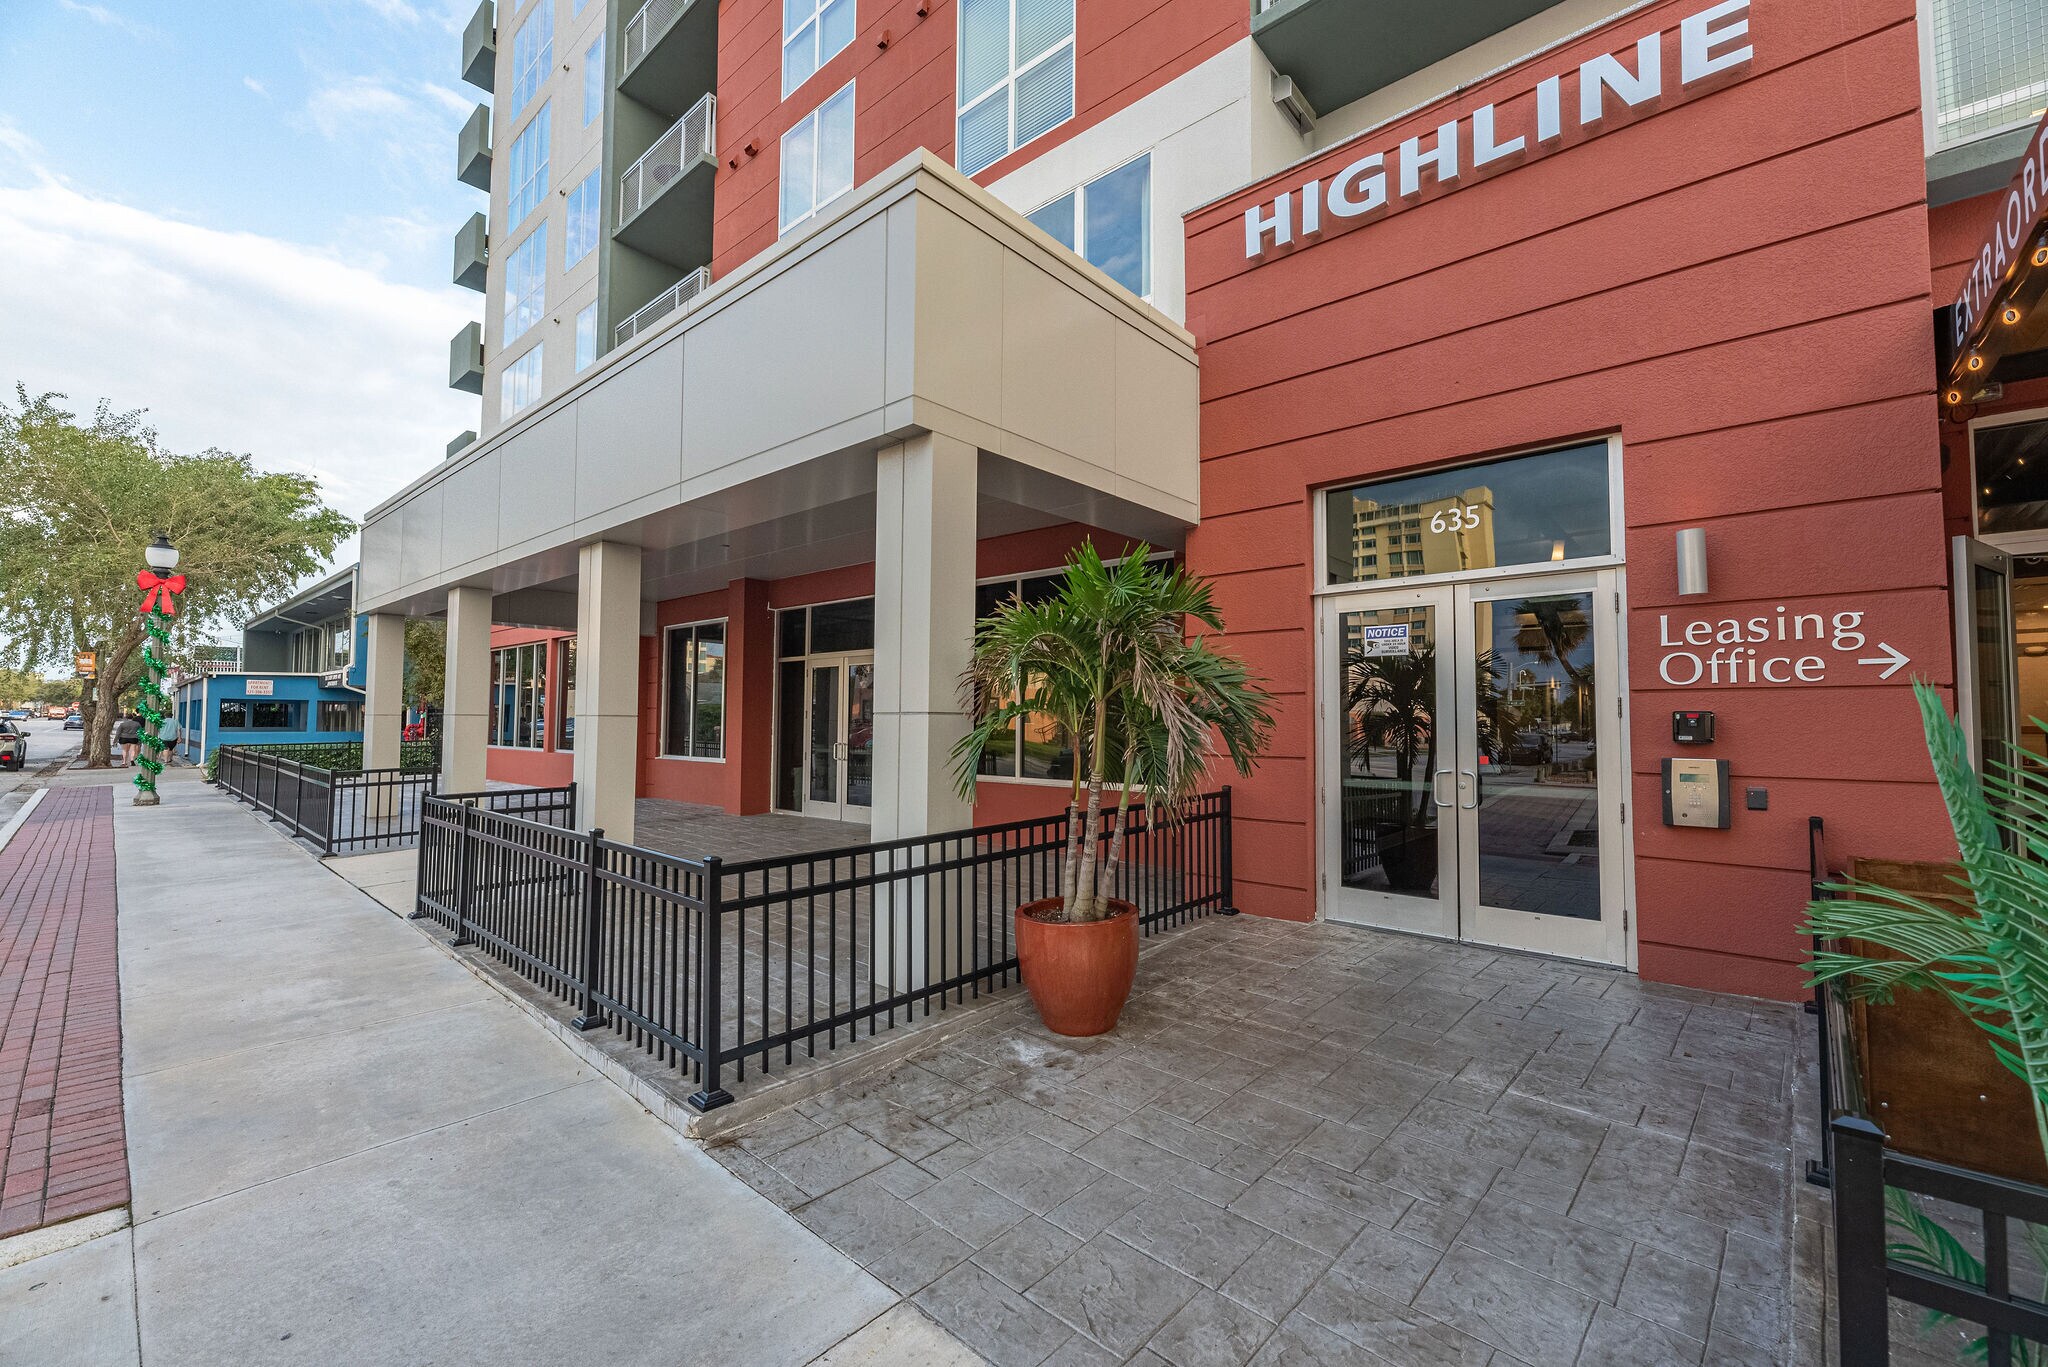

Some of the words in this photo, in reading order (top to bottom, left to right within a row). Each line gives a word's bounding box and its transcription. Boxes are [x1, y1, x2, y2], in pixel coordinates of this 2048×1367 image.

[1245, 0, 1754, 260] HIGHLINE
[1430, 504, 1480, 534] 635
[1367, 628, 1405, 638] NOTICE
[1659, 605, 1867, 651] Leasing
[1659, 647, 1826, 686] Office
